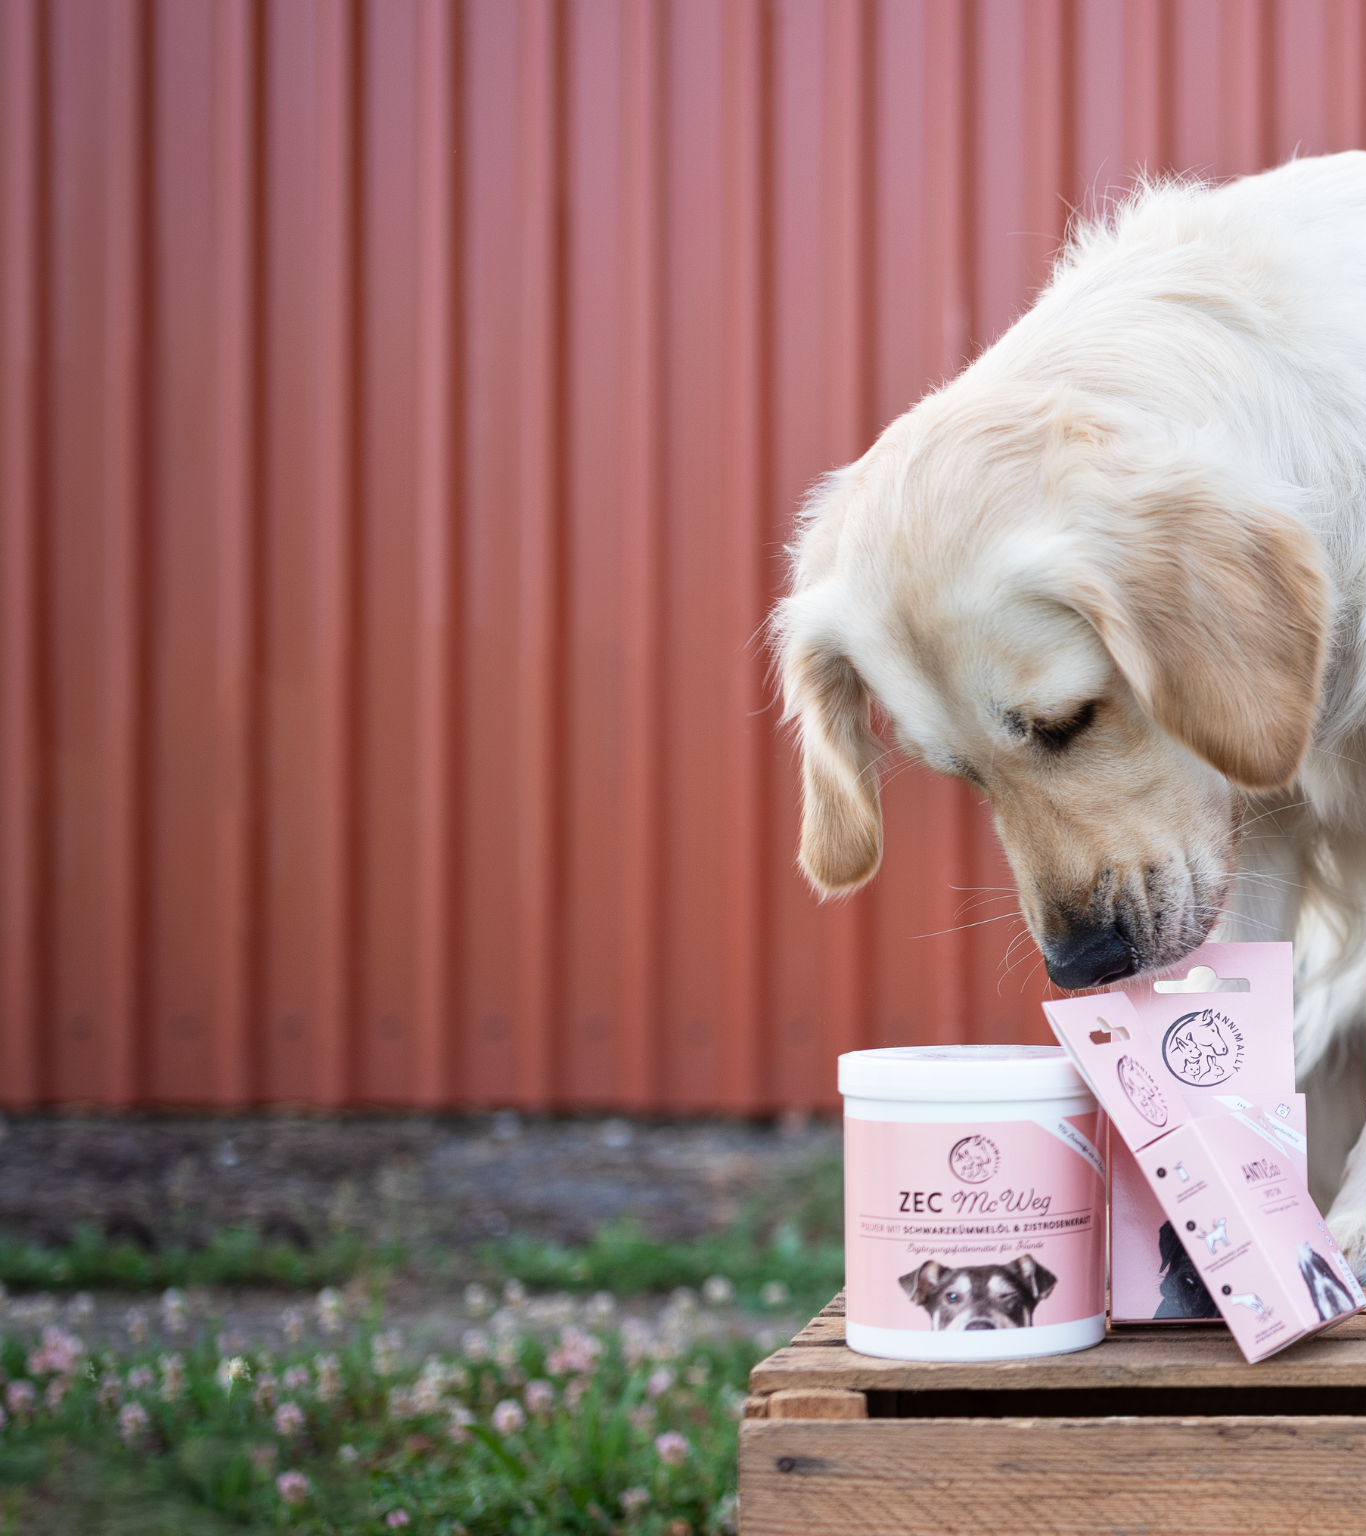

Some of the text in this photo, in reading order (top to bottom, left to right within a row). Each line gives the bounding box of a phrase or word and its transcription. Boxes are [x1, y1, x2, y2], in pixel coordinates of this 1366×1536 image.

[1214, 1012, 1245, 1072] ANNIMALLY
[898, 1191, 943, 1213] ZEC
[860, 1215, 1091, 1235] PULVER MIT SCHWARZKÜMMELÖL & ZISTROSENKRAUT
